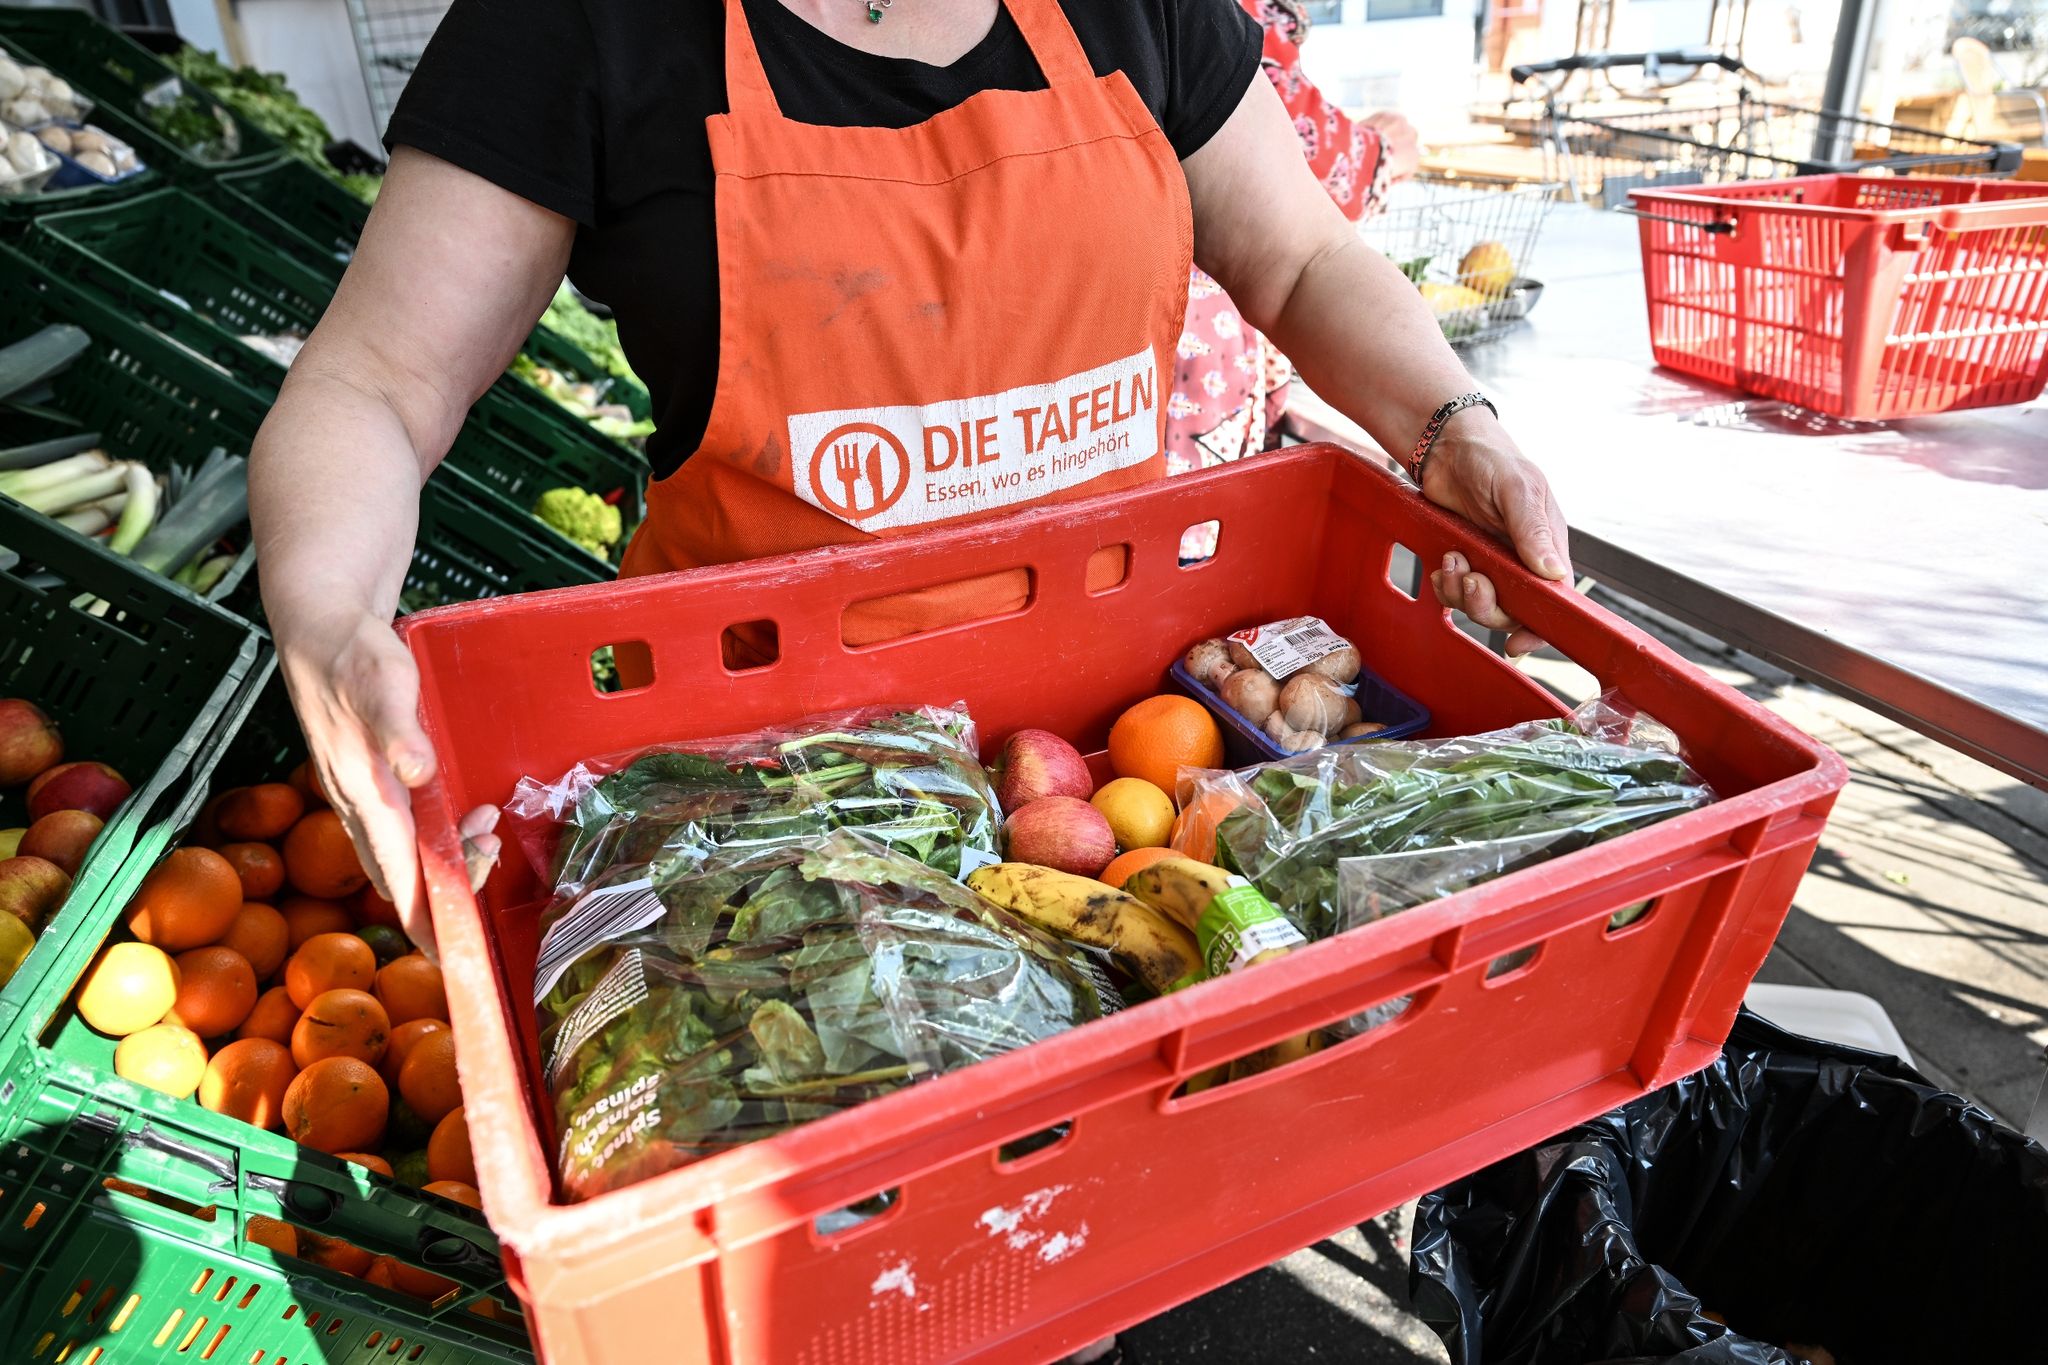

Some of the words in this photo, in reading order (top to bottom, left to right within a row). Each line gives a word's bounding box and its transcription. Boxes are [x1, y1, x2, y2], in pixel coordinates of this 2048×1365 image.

[923, 415, 1000, 473] DIE
[1013, 366, 1154, 455] TAFELN
[926, 477, 987, 502] Essen,
[992, 469, 1021, 488] wo
[1027, 466, 1046, 481] es
[1052, 429, 1130, 475] hingehört
